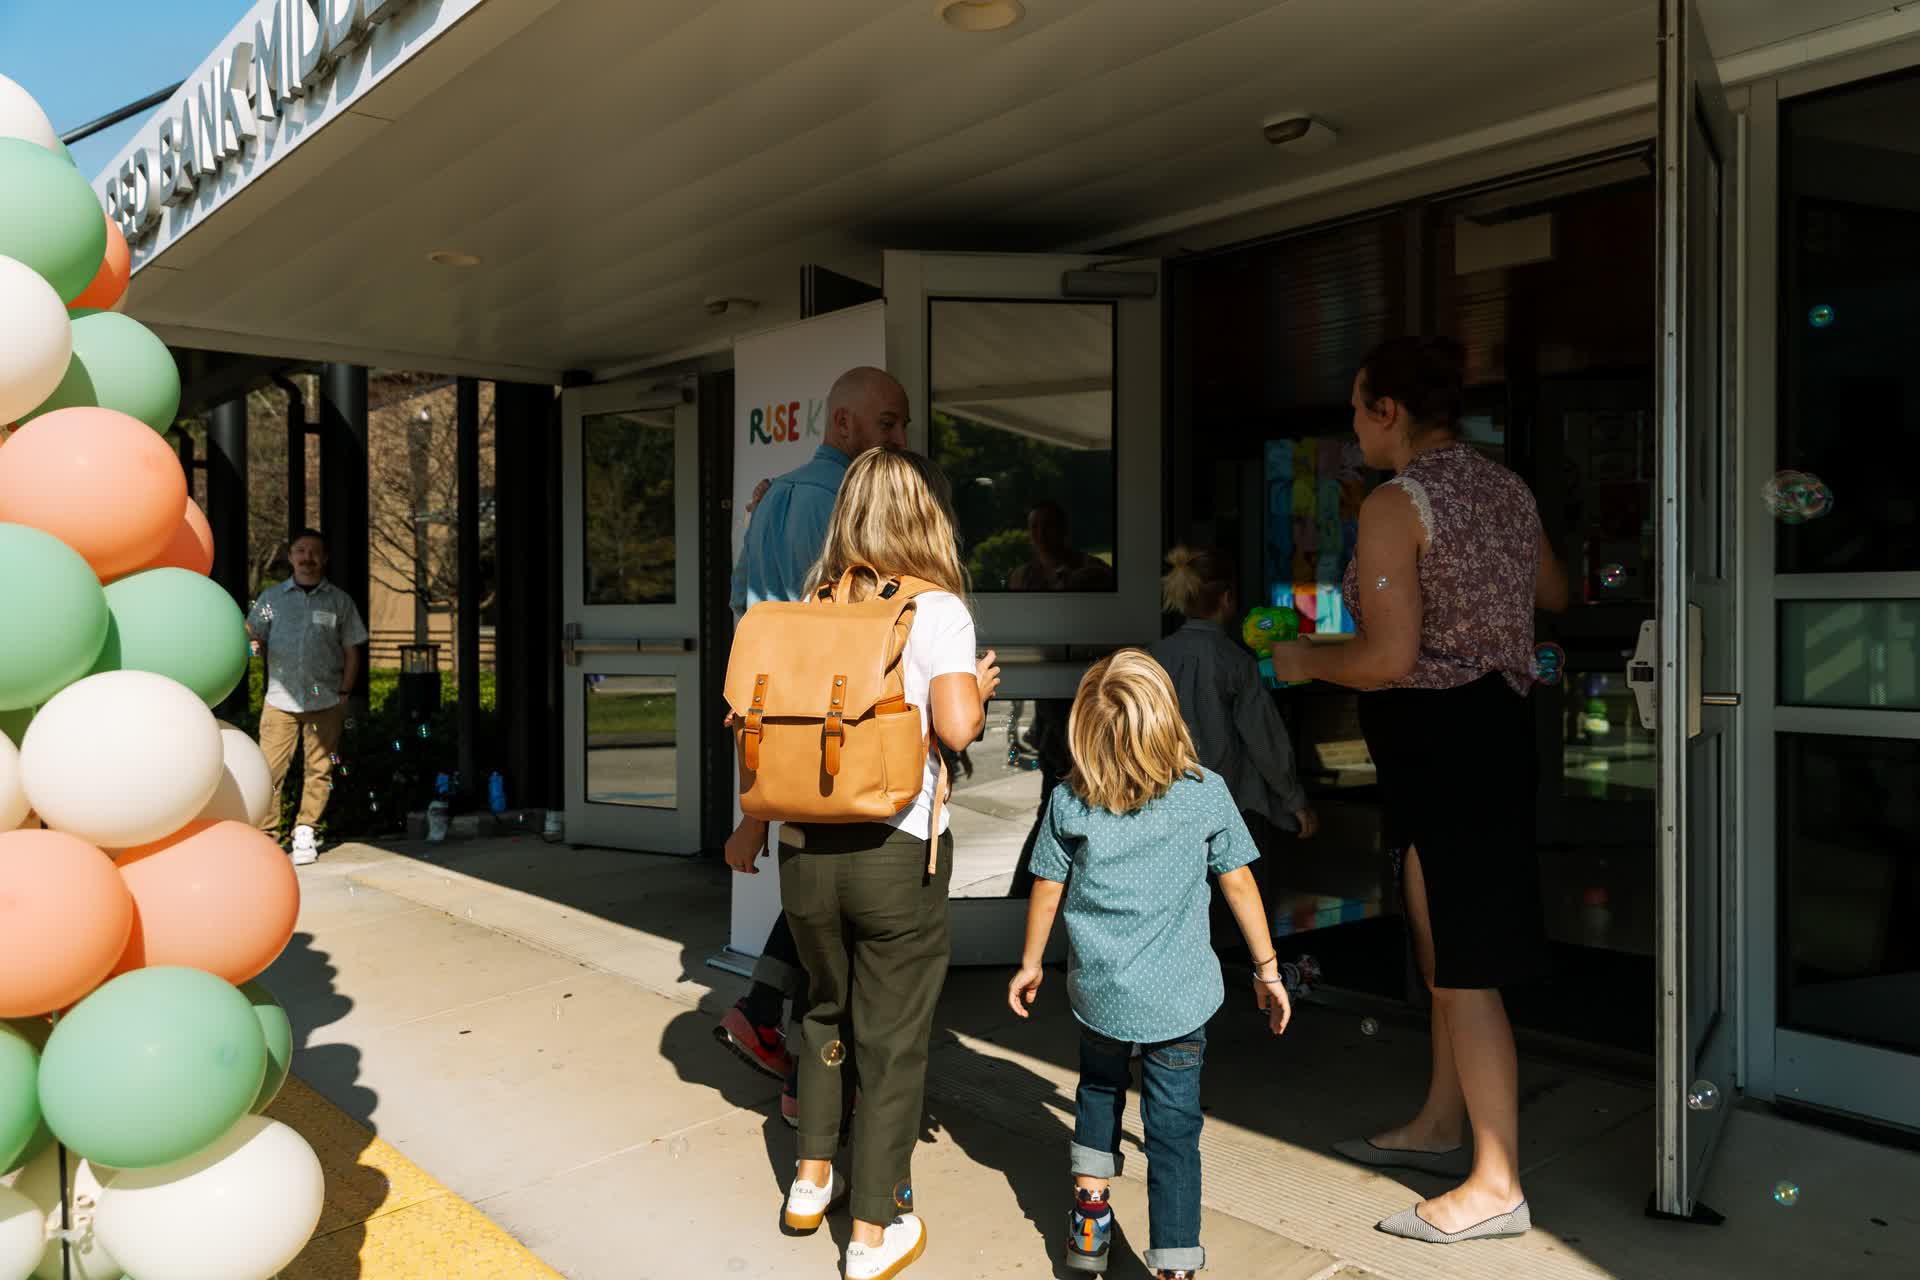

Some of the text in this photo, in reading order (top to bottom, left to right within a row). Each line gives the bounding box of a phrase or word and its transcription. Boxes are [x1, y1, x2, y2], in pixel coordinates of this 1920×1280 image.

[106, 147, 158, 243] RED
[160, 42, 257, 208] BANK
[749, 401, 801, 445] RISE
